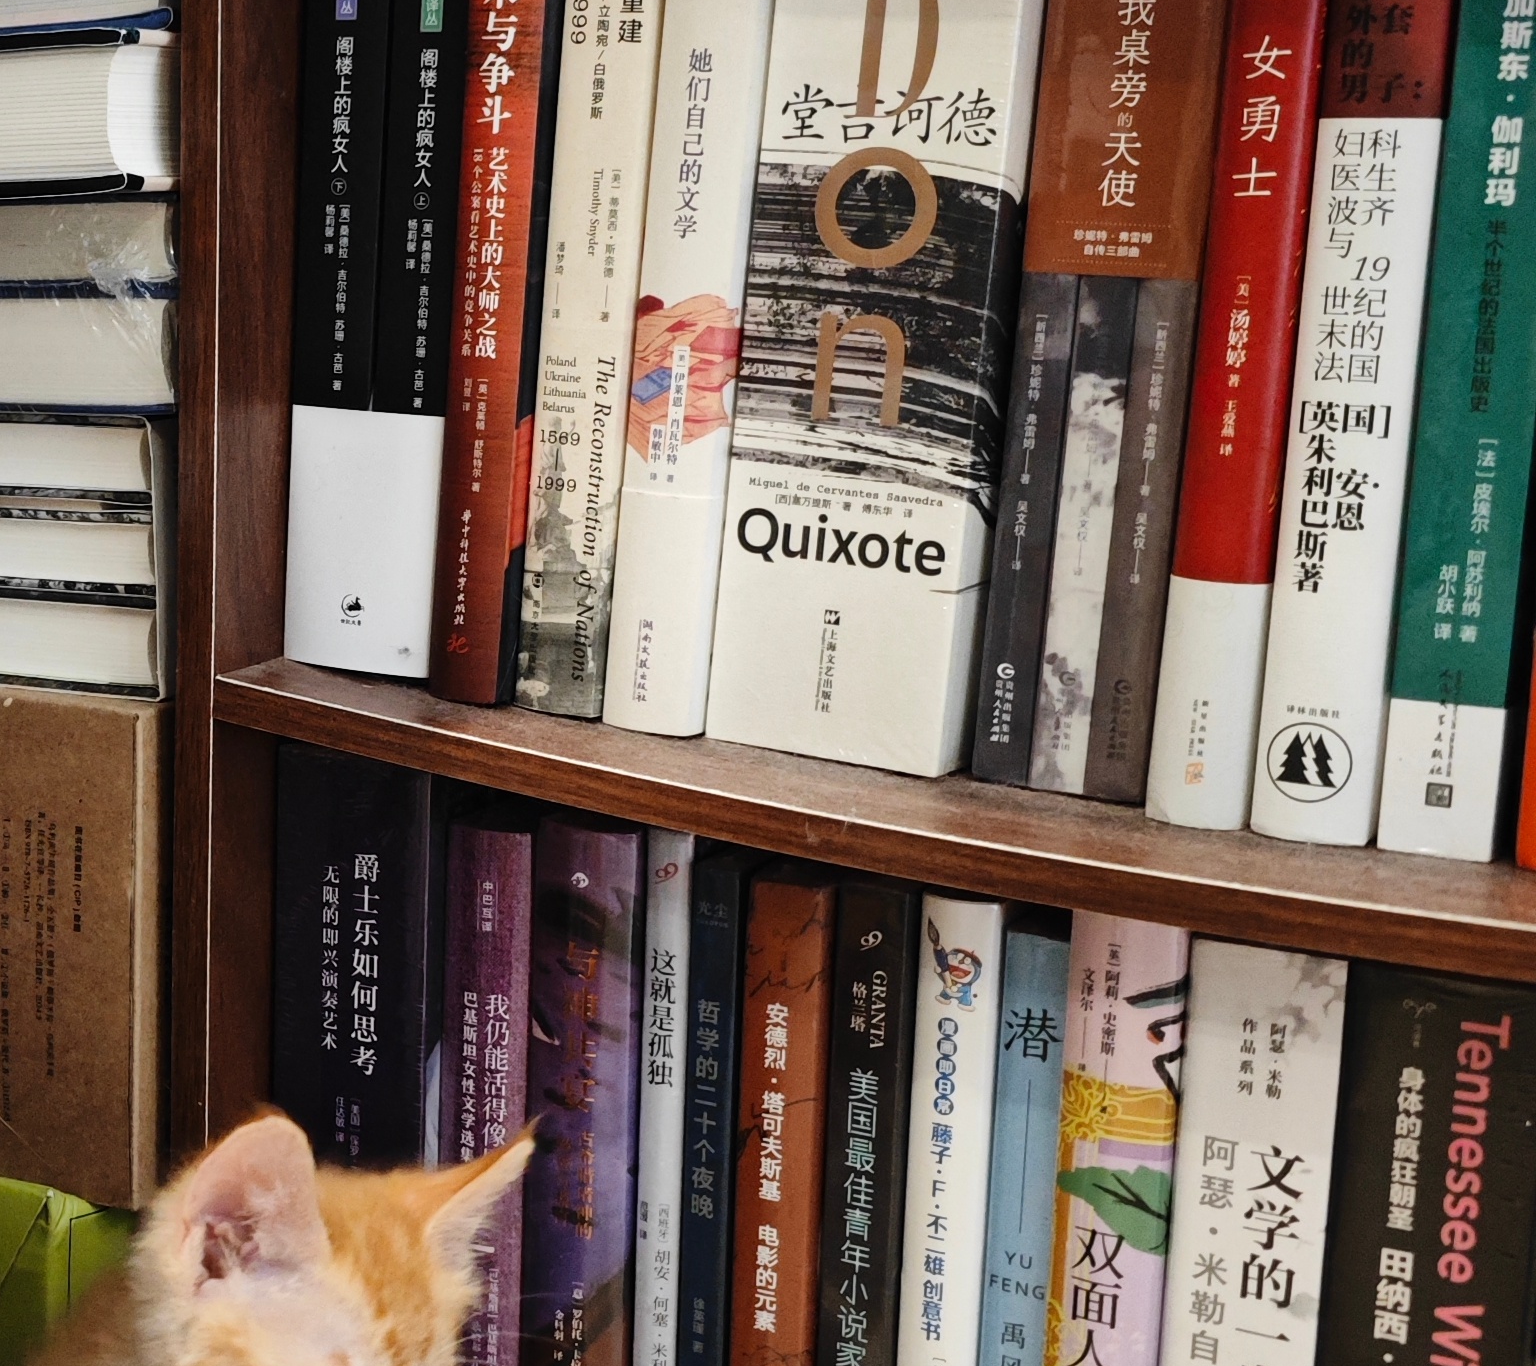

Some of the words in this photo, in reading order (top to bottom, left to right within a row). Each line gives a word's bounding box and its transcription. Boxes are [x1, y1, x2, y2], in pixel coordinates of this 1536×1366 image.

[331, 36, 354, 175] 阁楼上的疯女人
[413, 48, 439, 189] 阁楼上的疯女人
[673, 48, 714, 240] 她们自己的文学
[1232, 35, 1292, 198] 女勇士
[592, 169, 604, 216] Timothy
[474, 146, 509, 360] 艺术史上的大师之战
[587, 217, 600, 257] Snyder
[1074, 228, 1153, 244] 珍妮特·弗雷姆
[1082, 244, 1141, 258] 自传三部曲
[543, 385, 587, 400] Lithuania
[544, 370, 582, 384] Ukraine
[546, 355, 577, 369] Poland
[594, 356, 617, 396] The
[539, 428, 580, 447] 1569
[542, 400, 576, 415] Belarus
[535, 475, 577, 493] 1999
[582, 399, 614, 559] Reconstruction
[749, 477, 791, 492] Miguel
[796, 483, 812, 494] de
[816, 485, 880, 501] Cervantes
[886, 492, 944, 508] Saavedra
[736, 506, 947, 578] Quixote
[573, 569, 593, 595] of
[571, 599, 595, 683] Nations
[820, 629, 839, 715] 上海文艺出版社
[1286, 704, 1341, 720] 译林出版社
[320, 865, 340, 1051] 无限的即兴演奏艺术
[350, 852, 381, 1077] 爵士乐如何思考
[647, 948, 677, 1088] 这就是孤独
[850, 981, 866, 1034] 格兰塔
[870, 970, 888, 1049] GRANTA
[1004, 1007, 1064, 1065] 潜
[482, 994, 510, 1155] 我仍能活得像
[935, 1018, 958, 1115] 漫画即日常
[1237, 1018, 1259, 1096] 作品系列
[1266, 1022, 1287, 1100] 阿瑟·米勒
[690, 998, 720, 1221] 哲学的二十个夜晚
[758, 1003, 789, 1202] 安德烈·塔可夫斯基
[1386, 1066, 1425, 1232] 身体的疯狂朝圣
[1437, 1015, 1513, 1285] Tennessee
[754, 1225, 780, 1334] 电影的元素
[989, 1273, 1045, 1300] FENG
[1004, 1249, 1033, 1271] YU
